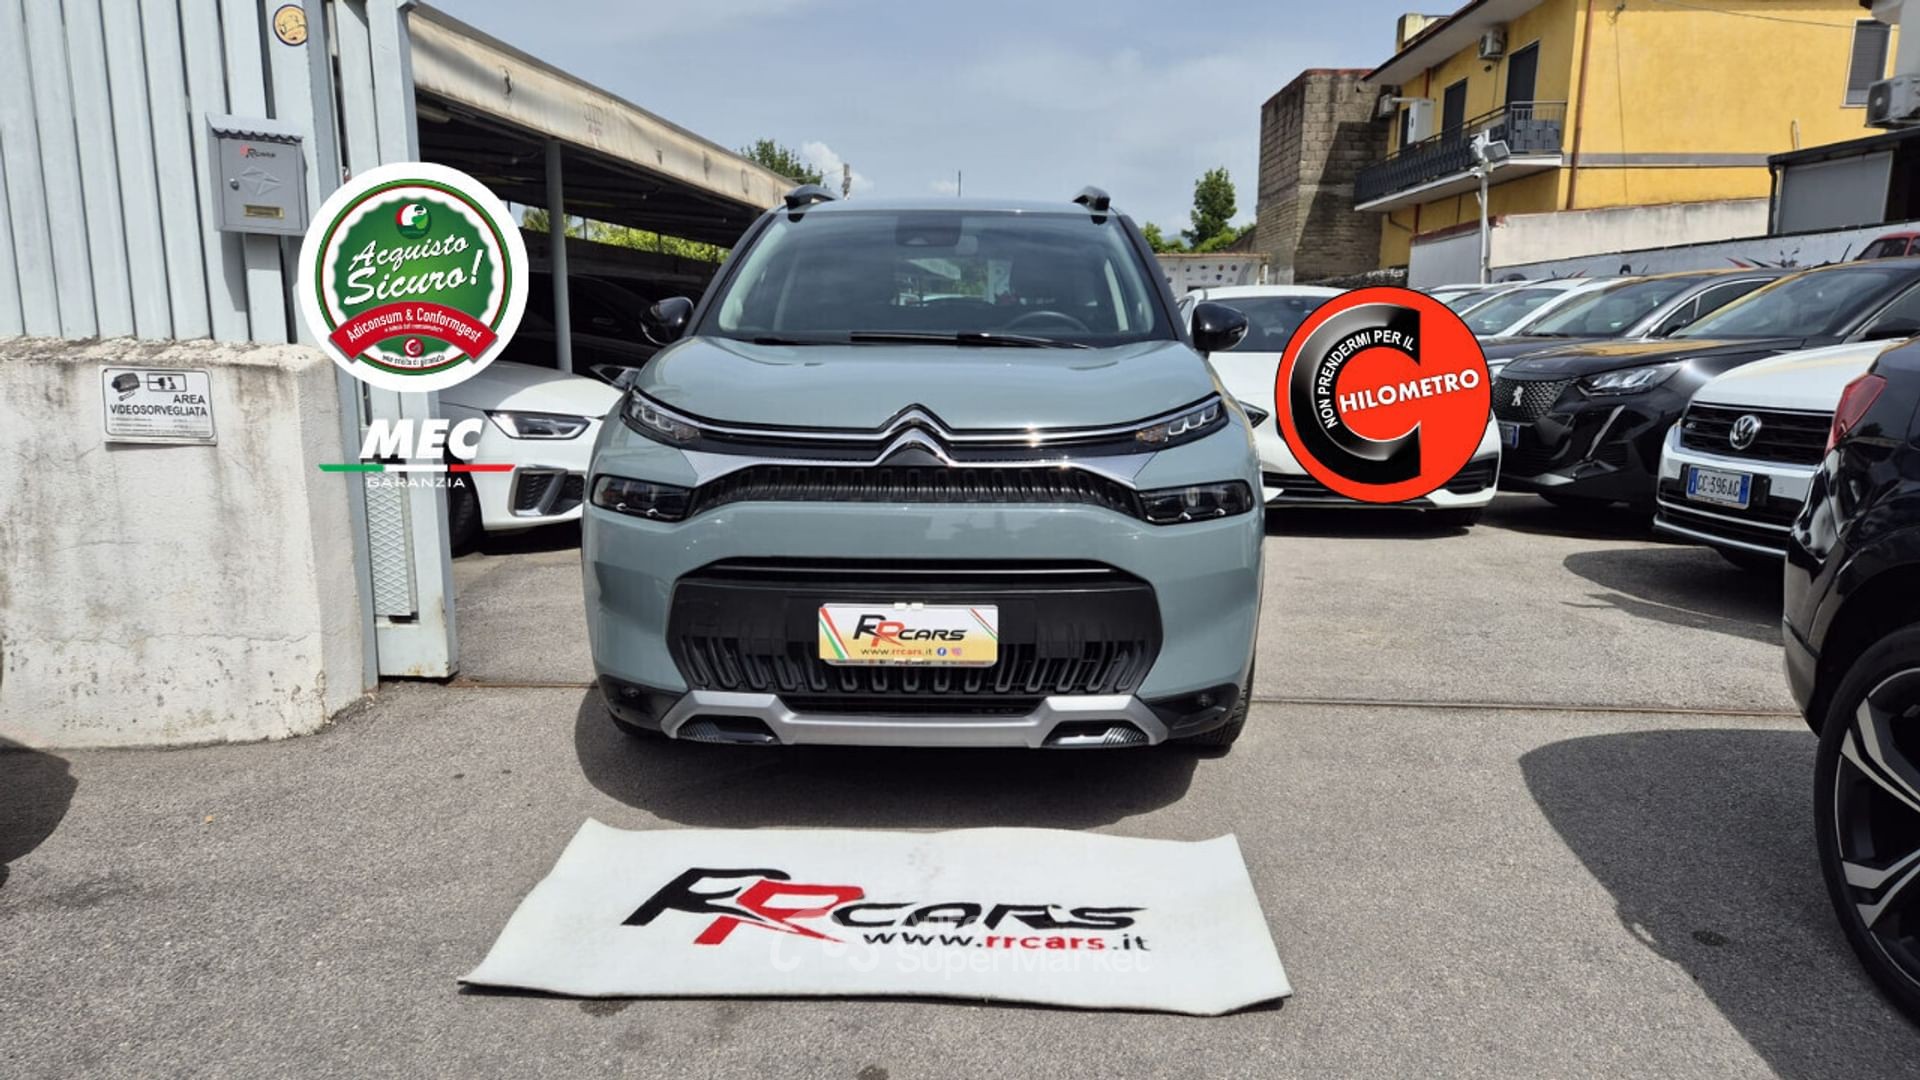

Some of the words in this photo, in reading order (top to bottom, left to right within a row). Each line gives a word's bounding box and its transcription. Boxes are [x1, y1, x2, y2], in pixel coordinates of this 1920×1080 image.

[173, 394, 206, 404] AREA
[110, 404, 208, 416] VIDEOSORVEGLIATA
[861, 648, 932, 656] www.rrcars.it
[863, 932, 1151, 951] www.rrcars.it
